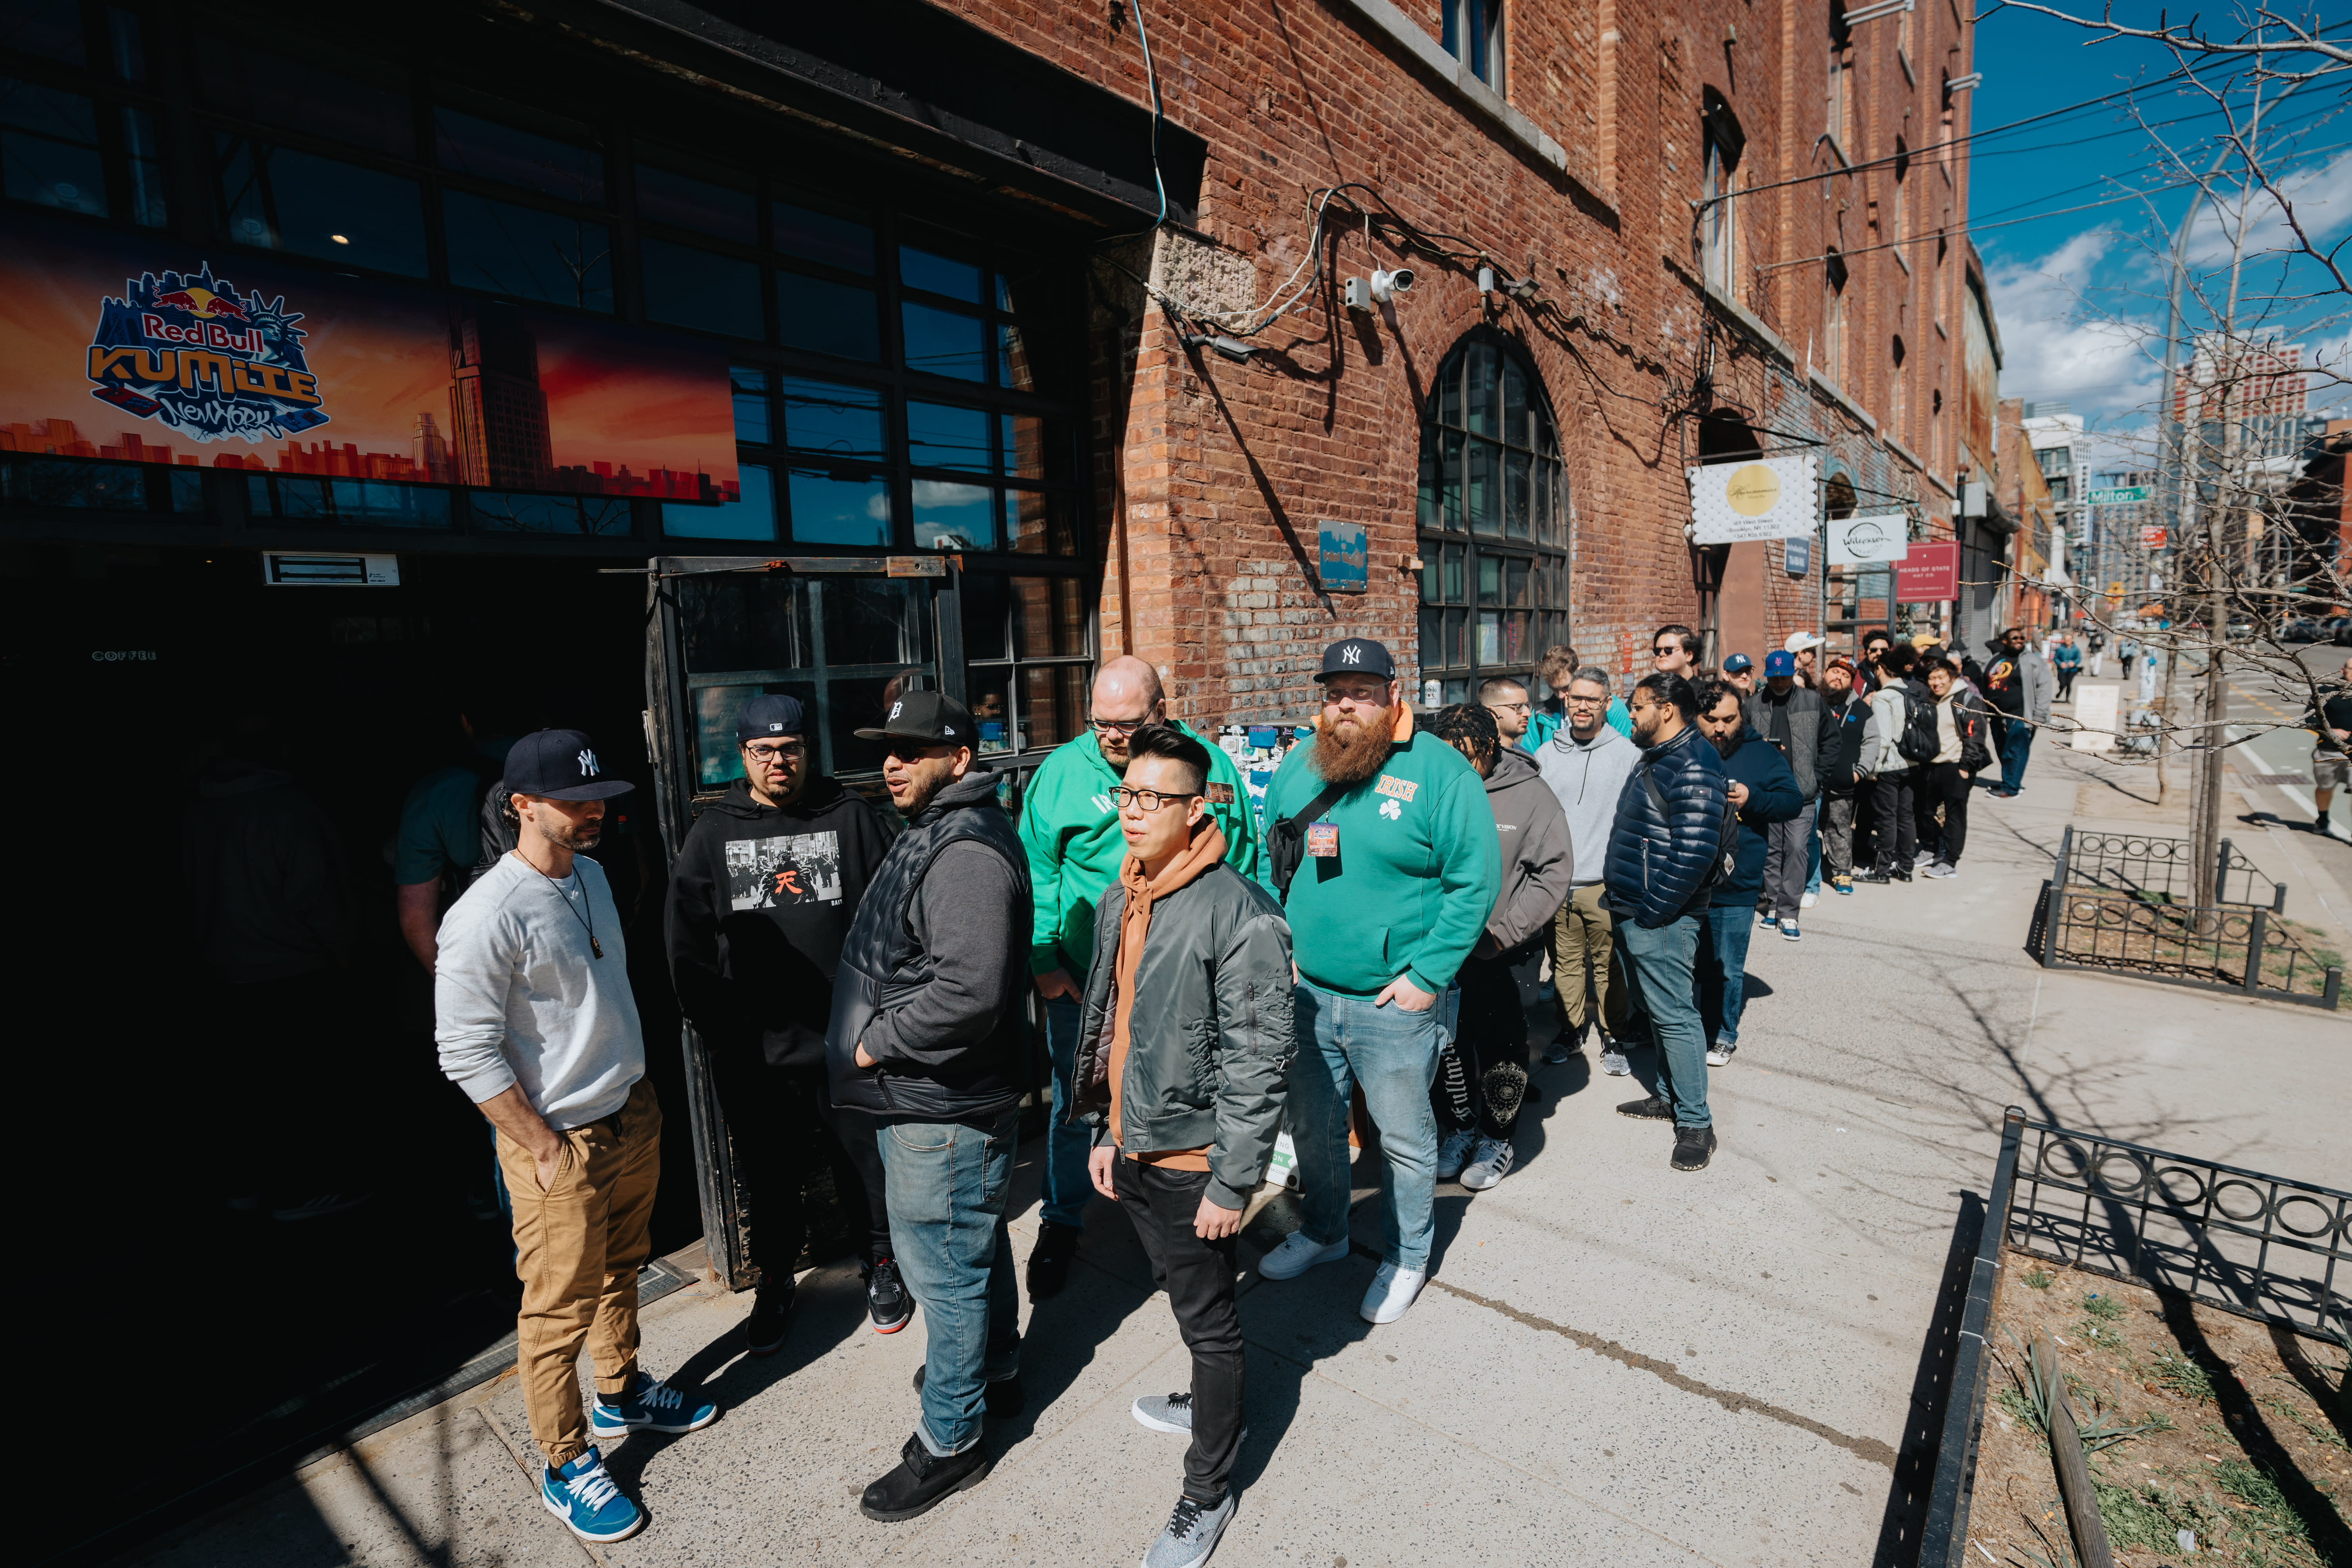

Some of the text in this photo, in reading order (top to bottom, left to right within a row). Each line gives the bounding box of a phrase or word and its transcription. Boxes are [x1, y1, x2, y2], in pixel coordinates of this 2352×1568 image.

[142, 313, 263, 352] Red Bull
[2091, 491, 2134, 502] Milton
[1843, 536, 1892, 545] Wilcoxson
[92, 651, 156, 661] COFFEE
[1342, 645, 1361, 664] NY
[1735, 654, 1746, 663] NY
[578, 749, 600, 776] NY
[1374, 774, 1418, 802] IRISH
[775, 870, 803, 894] 天
[1275, 1141, 1289, 1149] ING
